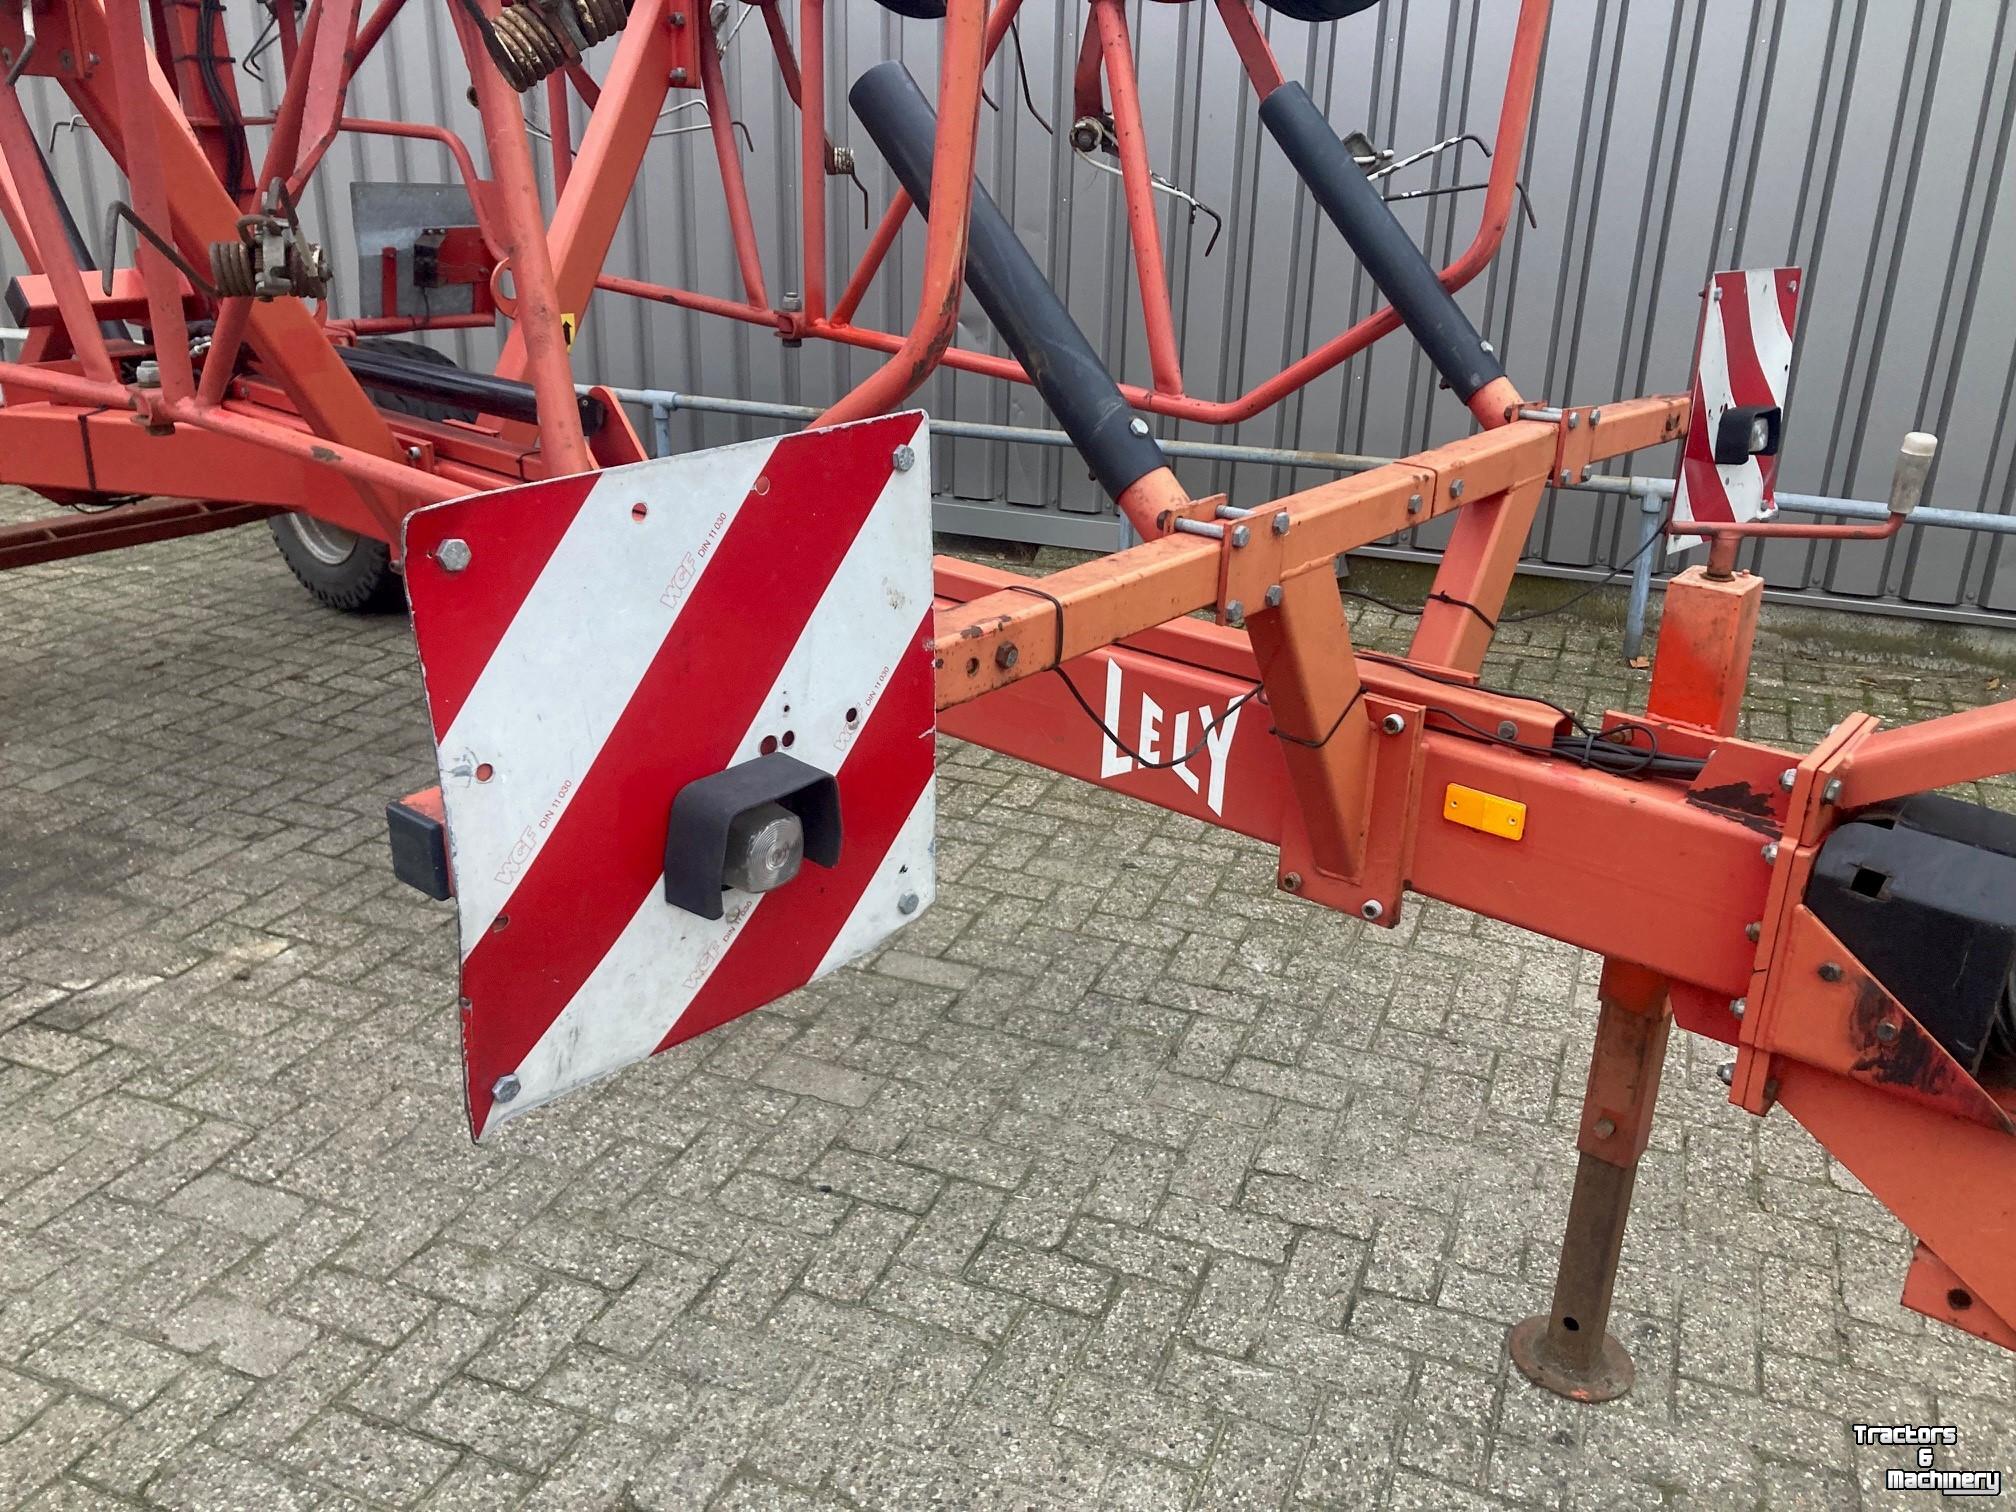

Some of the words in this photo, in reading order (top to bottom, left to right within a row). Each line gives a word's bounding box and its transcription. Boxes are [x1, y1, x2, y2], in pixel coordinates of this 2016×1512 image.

[697, 539, 711, 558] DIN
[865, 690, 876, 706] DIN
[1101, 656, 1246, 818] LELY
[539, 810, 554, 829] DIN
[723, 926, 736, 943] DIN
